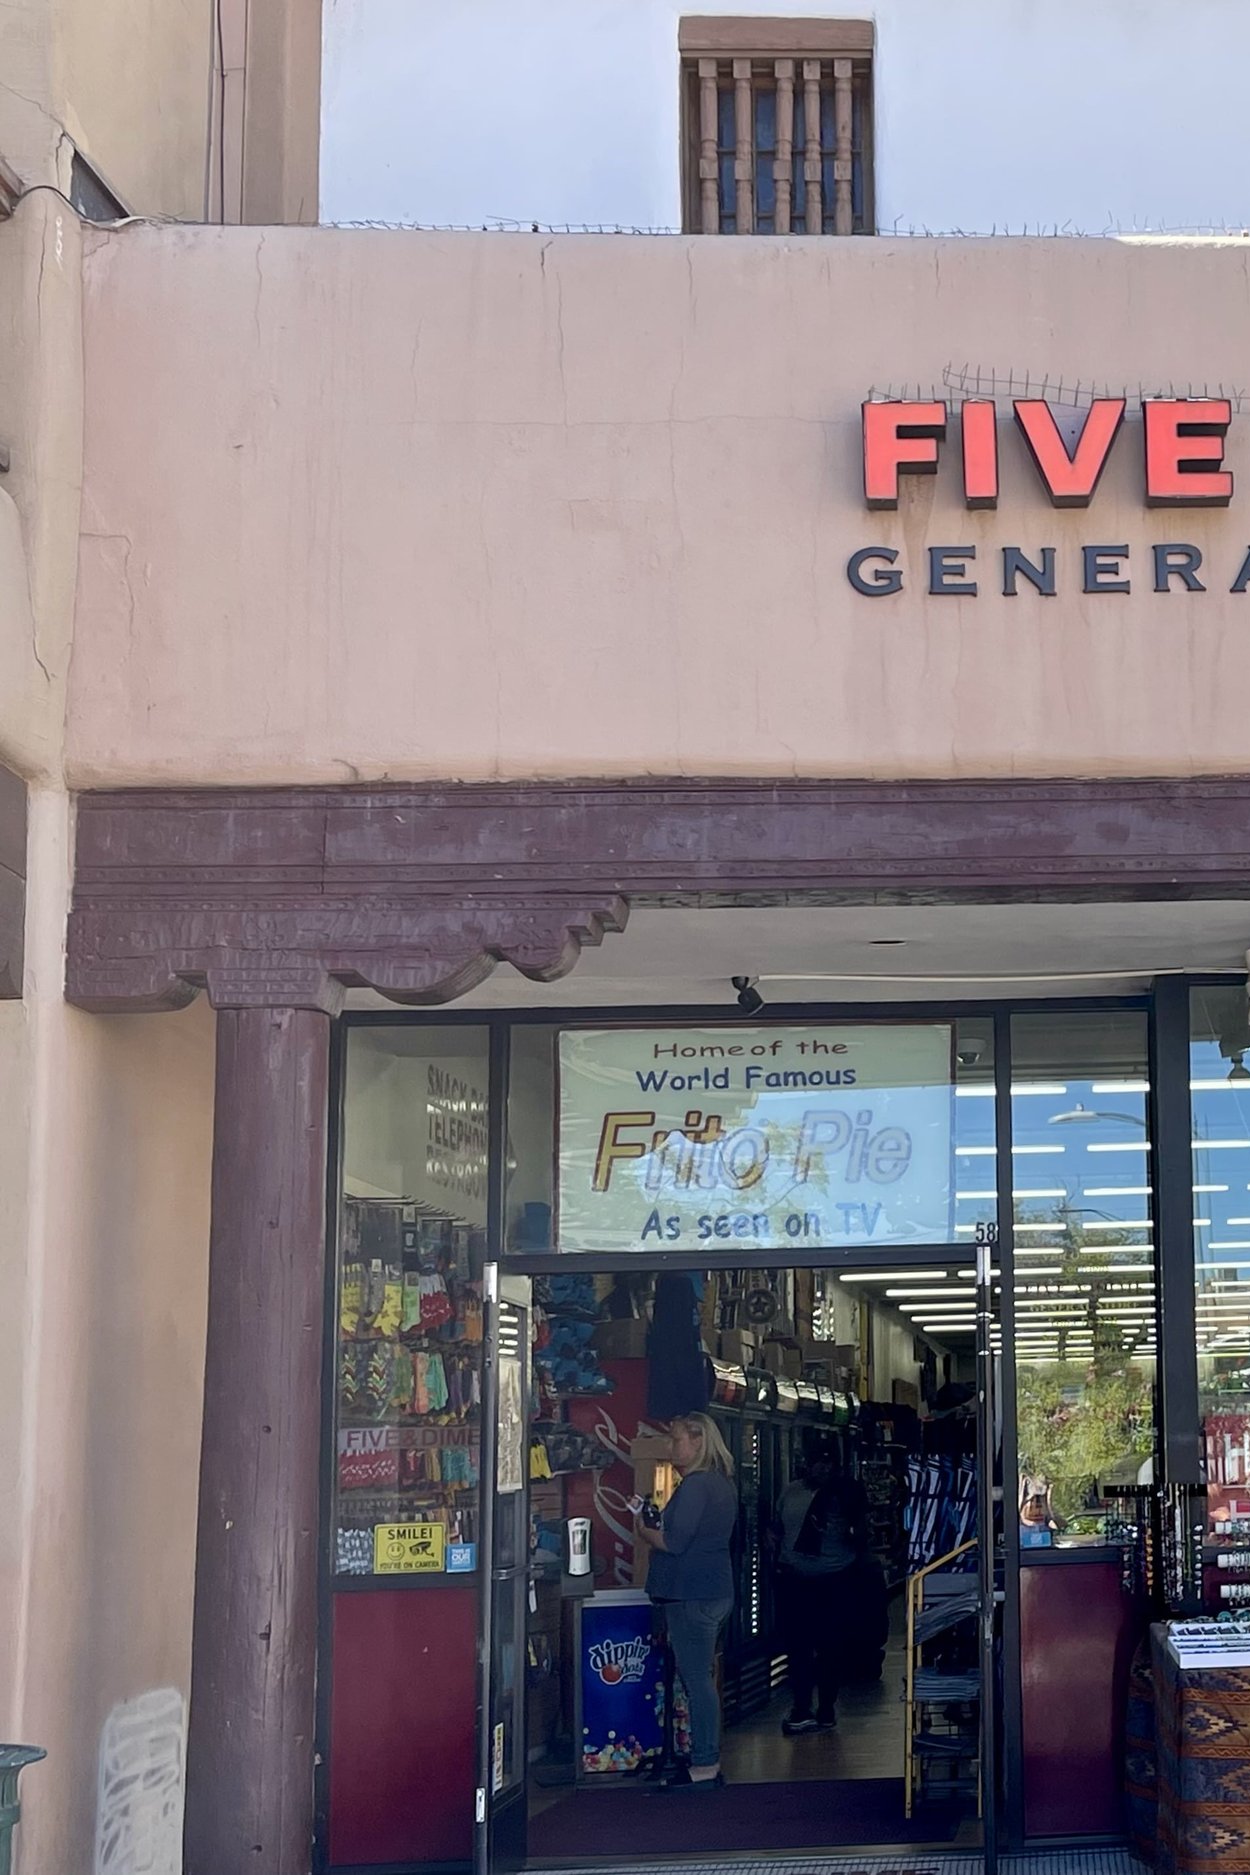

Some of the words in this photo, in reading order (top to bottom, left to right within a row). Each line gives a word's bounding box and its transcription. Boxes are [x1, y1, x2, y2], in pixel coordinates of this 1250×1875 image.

[862, 397, 1233, 510] FIVE
[653, 1041, 744, 1059] Home
[750, 1040, 783, 1058] of
[796, 1039, 848, 1056] the
[636, 1067, 730, 1092] World
[745, 1066, 857, 1089] Famous
[592, 1110, 769, 1192] Frito
[793, 1109, 912, 1184] Pie
[641, 1209, 681, 1241] As
[697, 1212, 769, 1239] seen
[785, 1211, 820, 1237] on
[835, 1202, 882, 1237] TV
[976, 1222, 996, 1242] 58
[346, 1429, 400, 1449] FIVE
[402, 1429, 417, 1447] &
[422, 1428, 480, 1447] DIME
[387, 1527, 433, 1540] SMILE!
